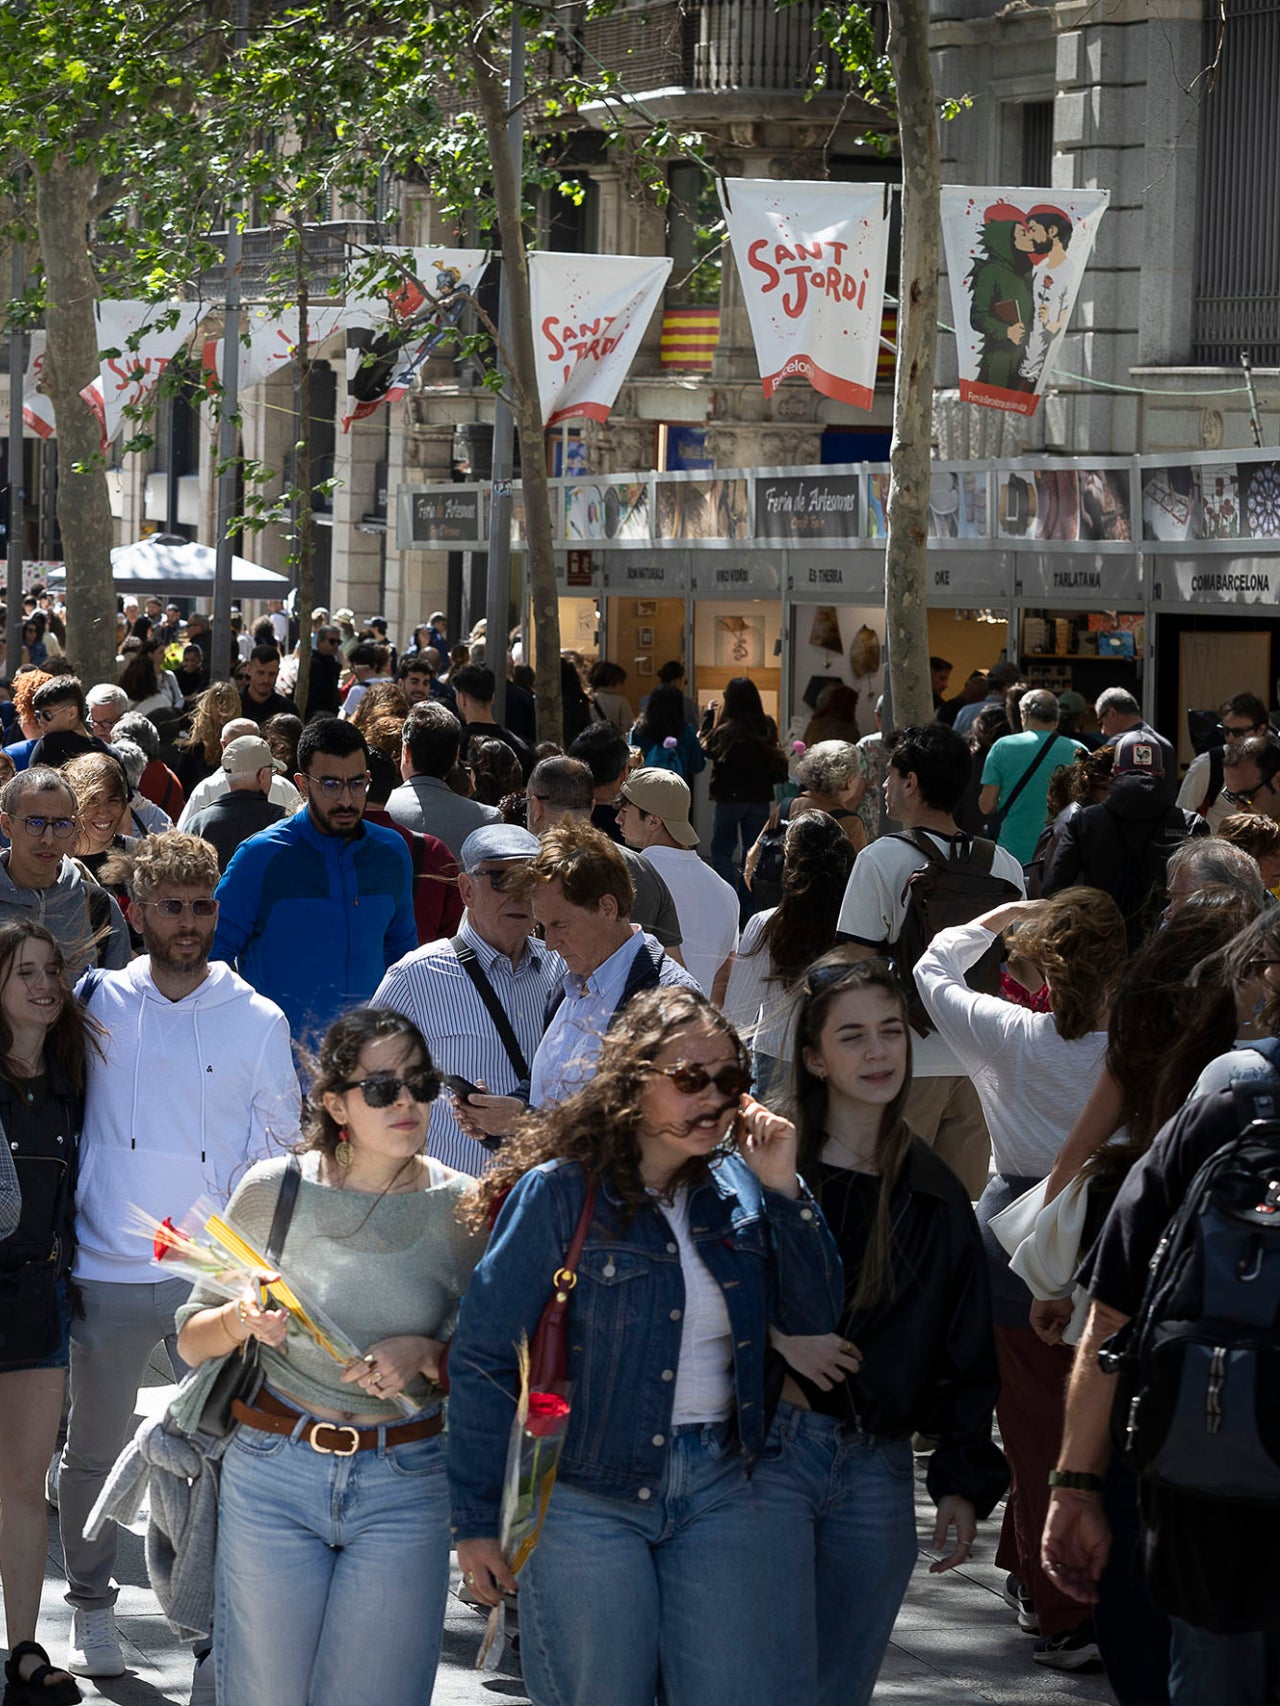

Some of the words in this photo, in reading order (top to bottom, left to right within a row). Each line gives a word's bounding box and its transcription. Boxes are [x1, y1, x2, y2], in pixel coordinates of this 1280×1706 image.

[748, 239, 848, 293] SANT
[542, 316, 617, 361] SANT
[1054, 572, 1101, 588] TARLATANA
[1191, 574, 1269, 591] COMABARCELONA
